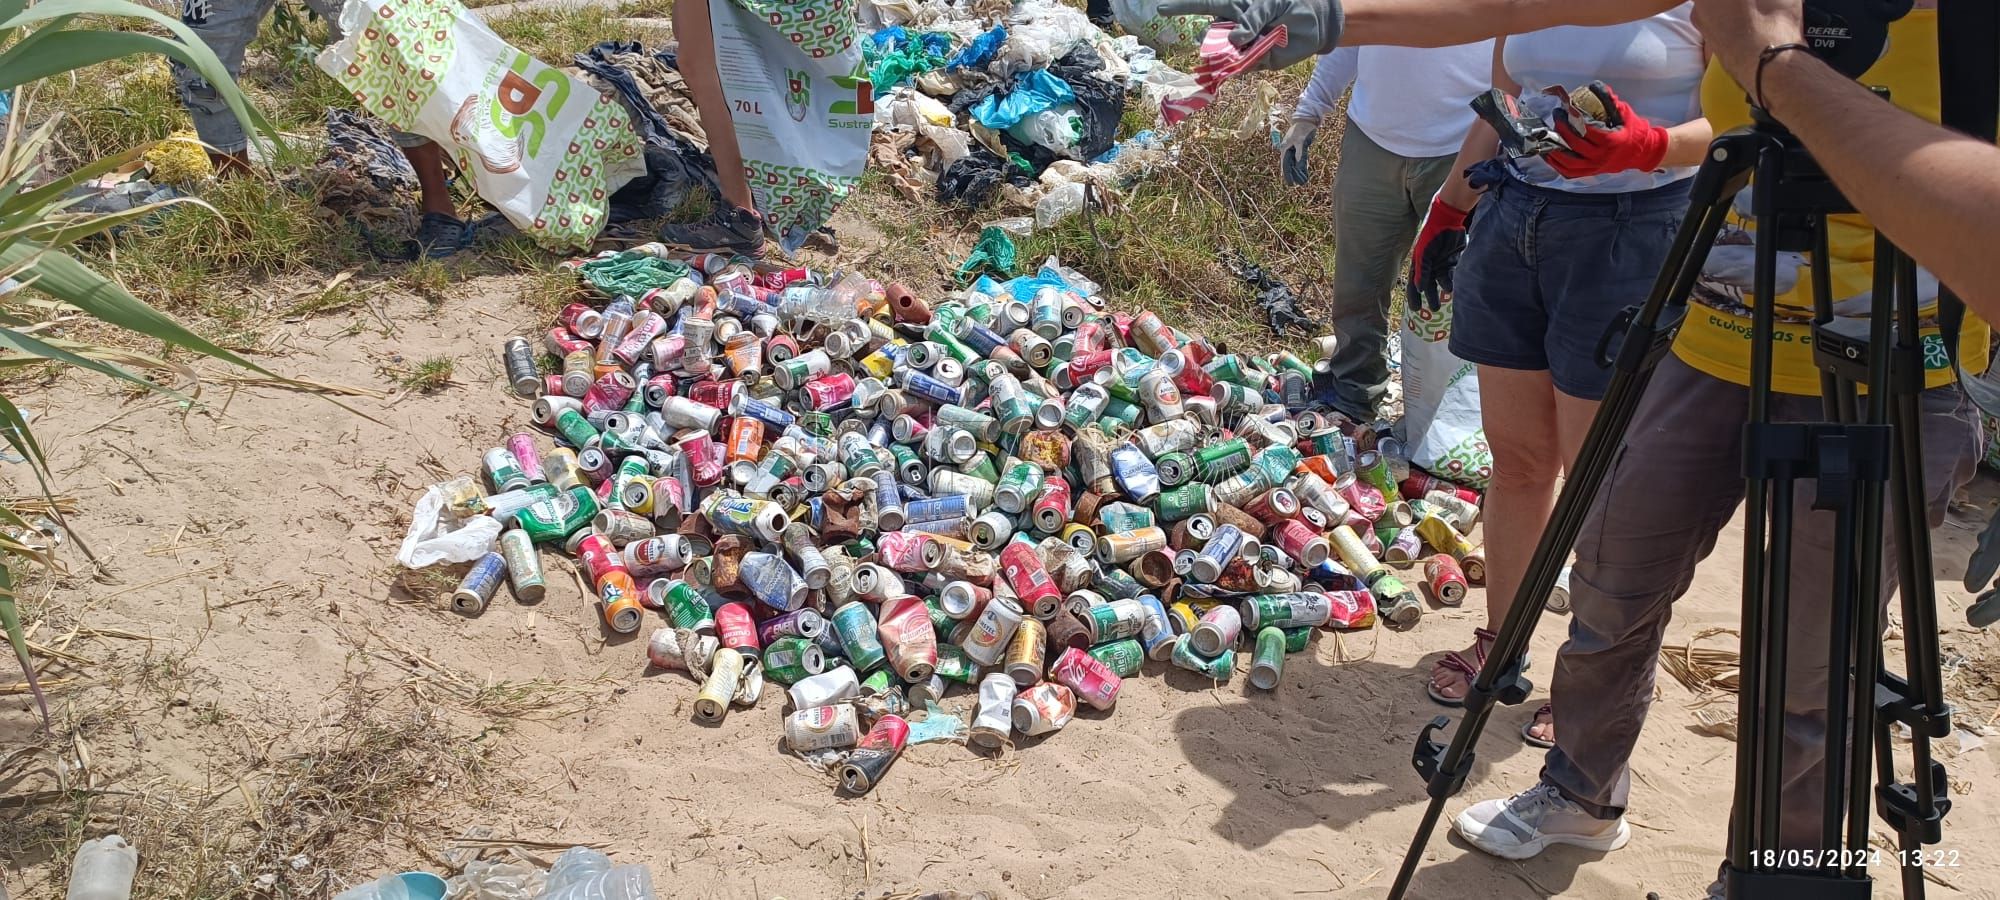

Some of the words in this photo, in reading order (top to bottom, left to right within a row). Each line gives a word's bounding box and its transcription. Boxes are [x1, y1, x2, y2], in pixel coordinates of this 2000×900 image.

[1807, 26, 1849, 36] DEREE
[1814, 38, 1836, 48] DV8
[734, 99, 751, 113] 70
[754, 101, 763, 115] L
[828, 118, 874, 129] Sustrat
